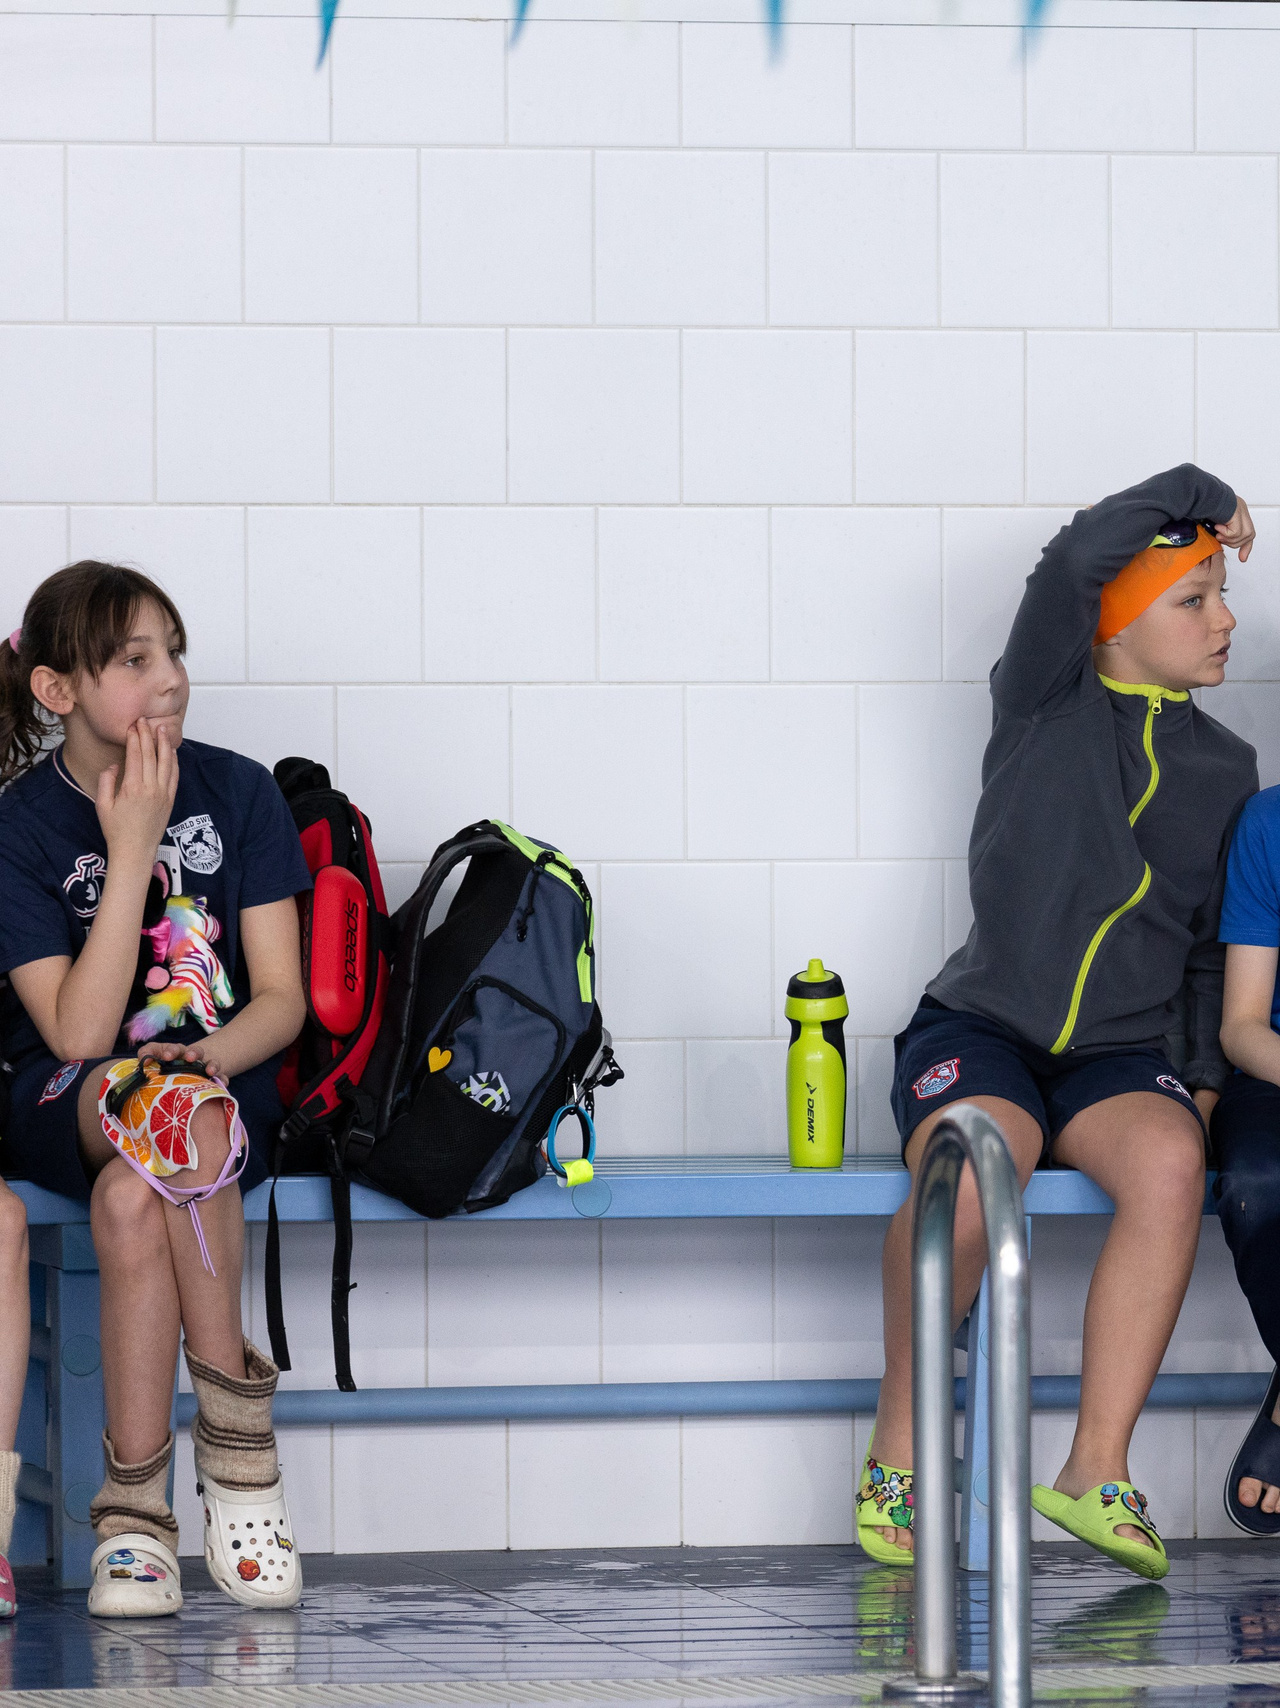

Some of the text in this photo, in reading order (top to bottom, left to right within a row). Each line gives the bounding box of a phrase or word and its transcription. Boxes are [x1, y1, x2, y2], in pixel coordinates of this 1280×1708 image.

[169, 820, 195, 835] WORLD
[195, 815, 211, 826] SWI
[344, 898, 359, 993] speedo
[806, 1098, 815, 1144] DEMIX
